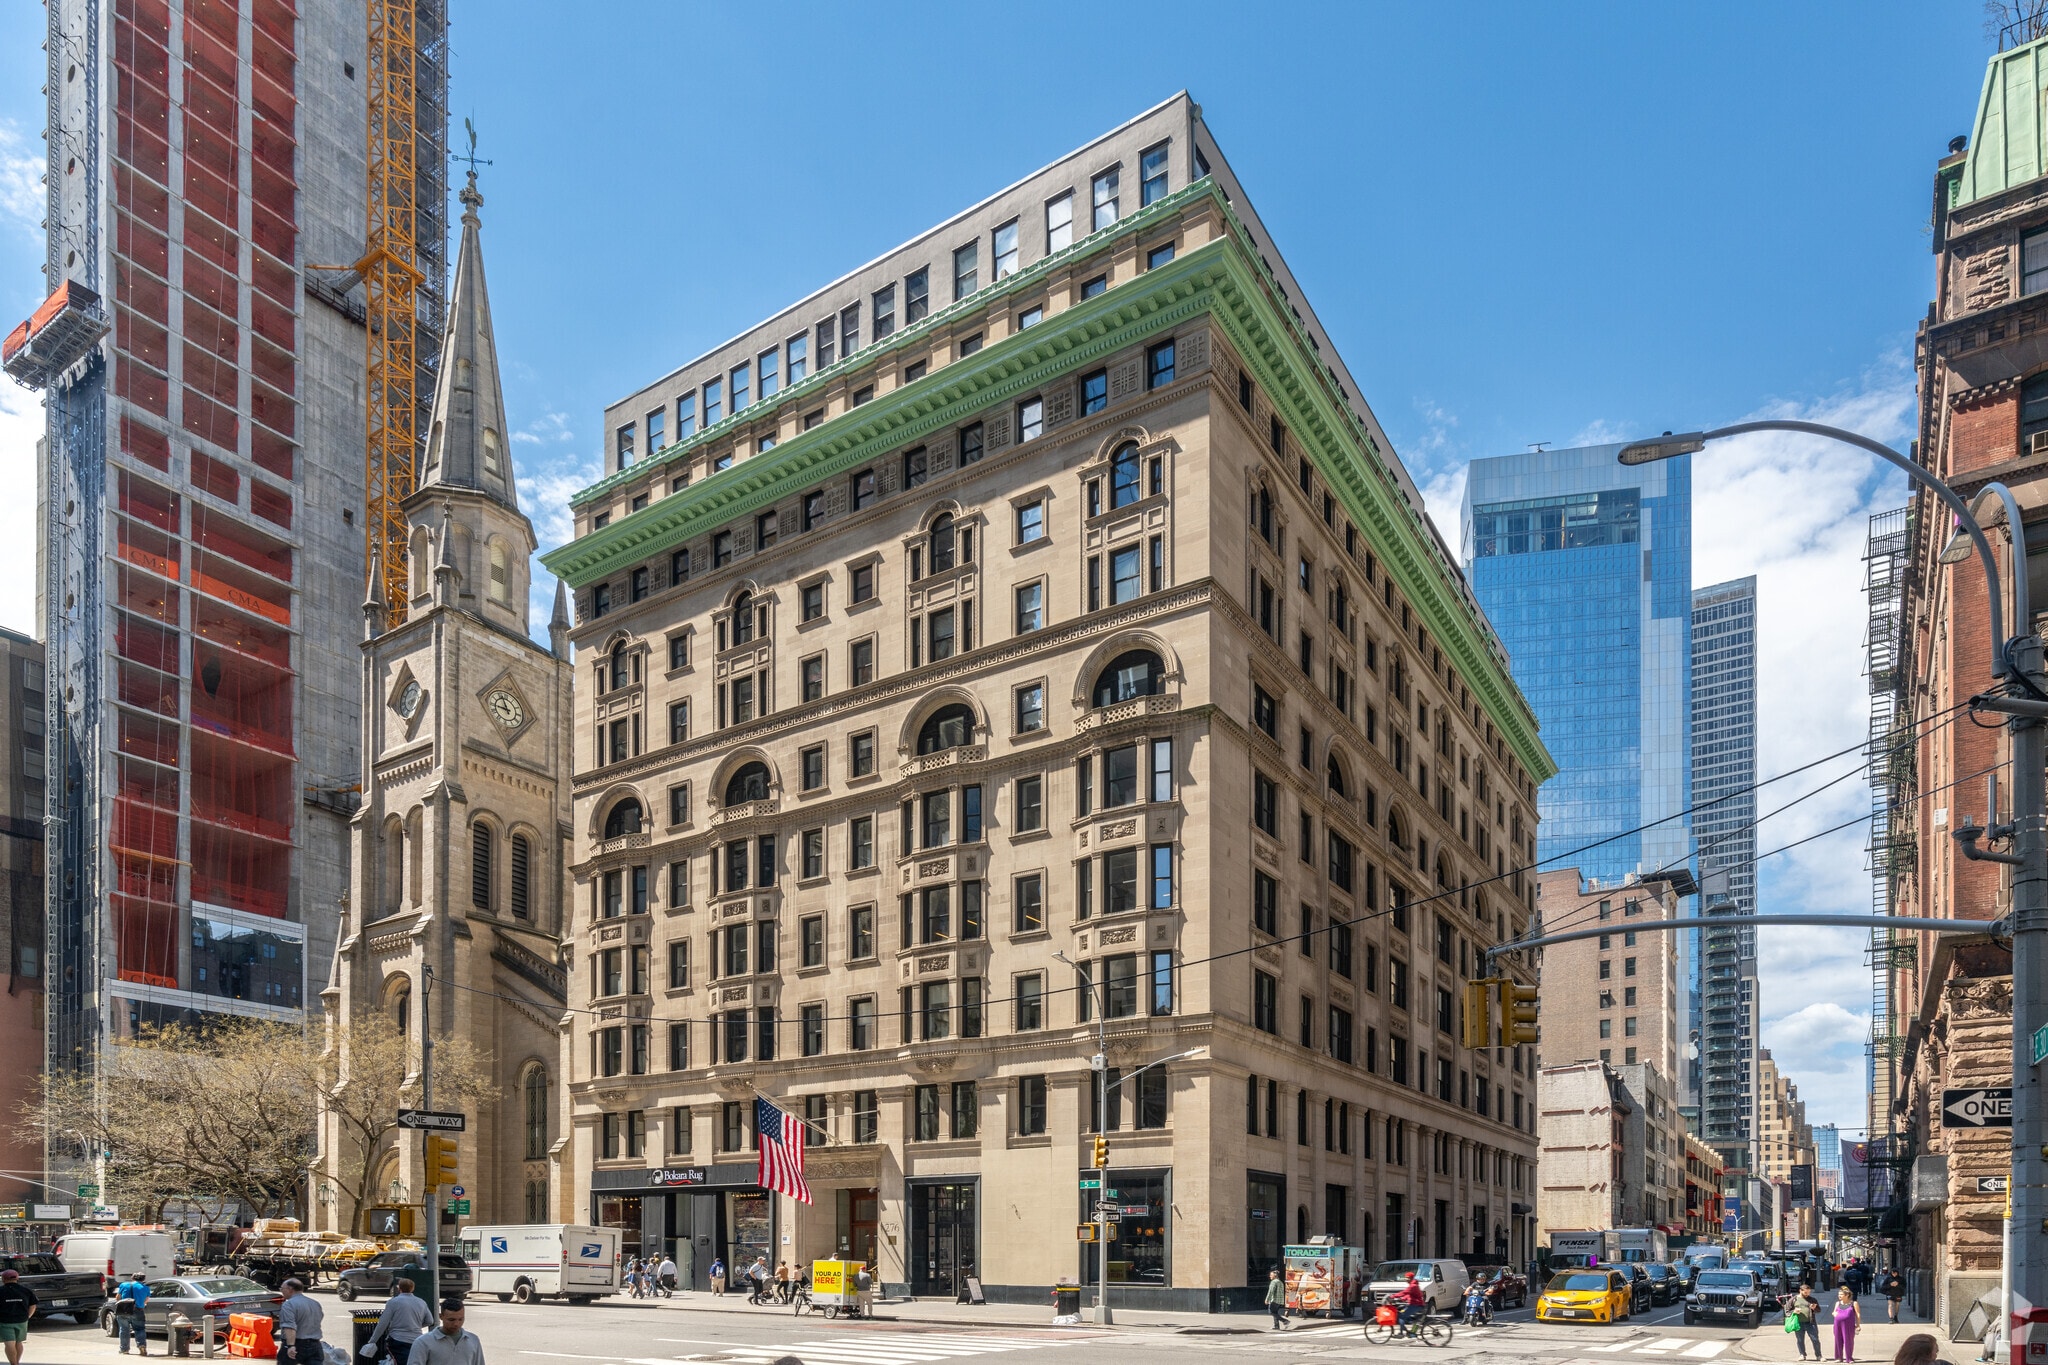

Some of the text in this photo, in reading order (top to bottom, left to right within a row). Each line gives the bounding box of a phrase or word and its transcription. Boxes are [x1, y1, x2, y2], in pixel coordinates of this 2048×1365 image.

[130, 550, 168, 571] CMA
[228, 589, 261, 612] CMA
[2035, 1035, 2039, 1059] E
[1964, 1100, 2012, 1116] ONE
[406, 1115, 460, 1126] ONE WAY
[664, 1169, 703, 1182] Bokara Rug
[885, 1223, 900, 1233] 276
[1287, 1249, 1320, 1257] TORADE
[814, 1276, 835, 1285] HERE
